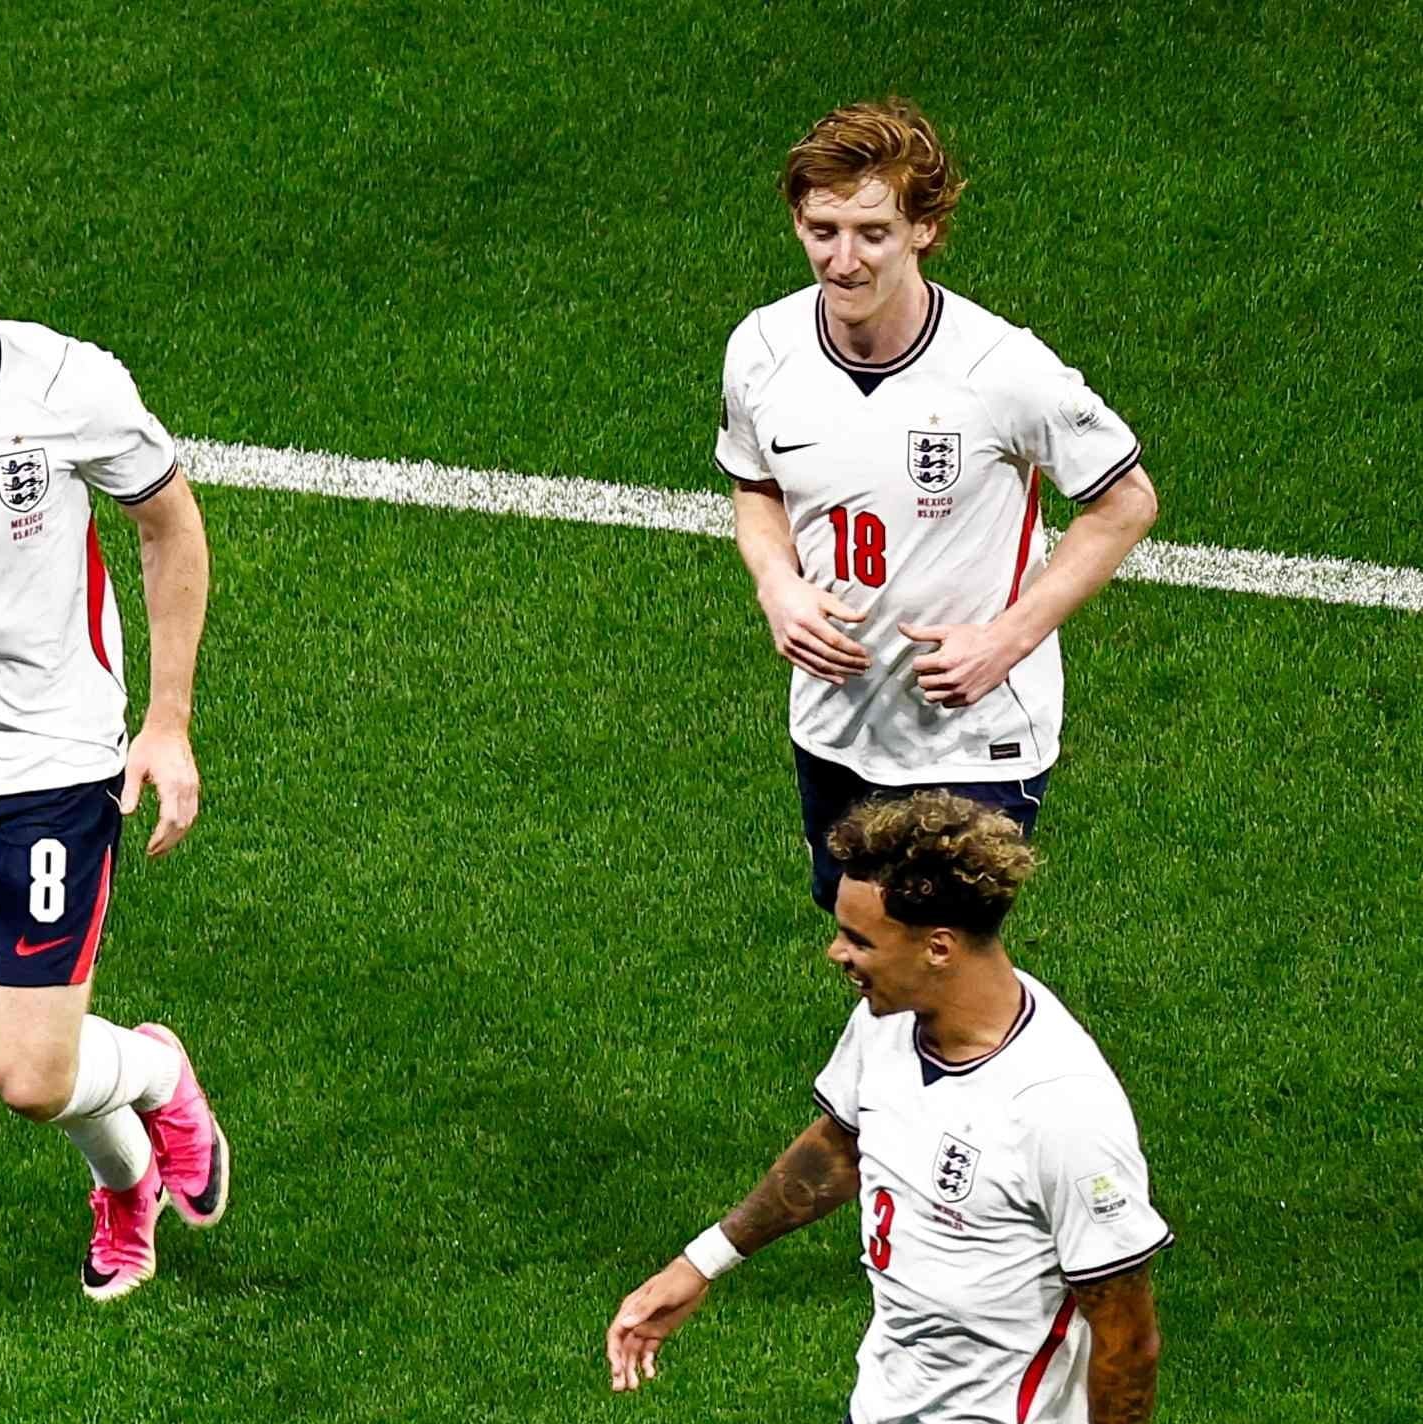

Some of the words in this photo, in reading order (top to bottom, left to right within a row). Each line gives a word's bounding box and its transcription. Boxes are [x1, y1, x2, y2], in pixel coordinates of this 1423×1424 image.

[11, 511, 44, 529] MEXICO
[829, 505, 886, 588] 18
[29, 838, 67, 923] 8
[869, 1188, 895, 1271] 3
